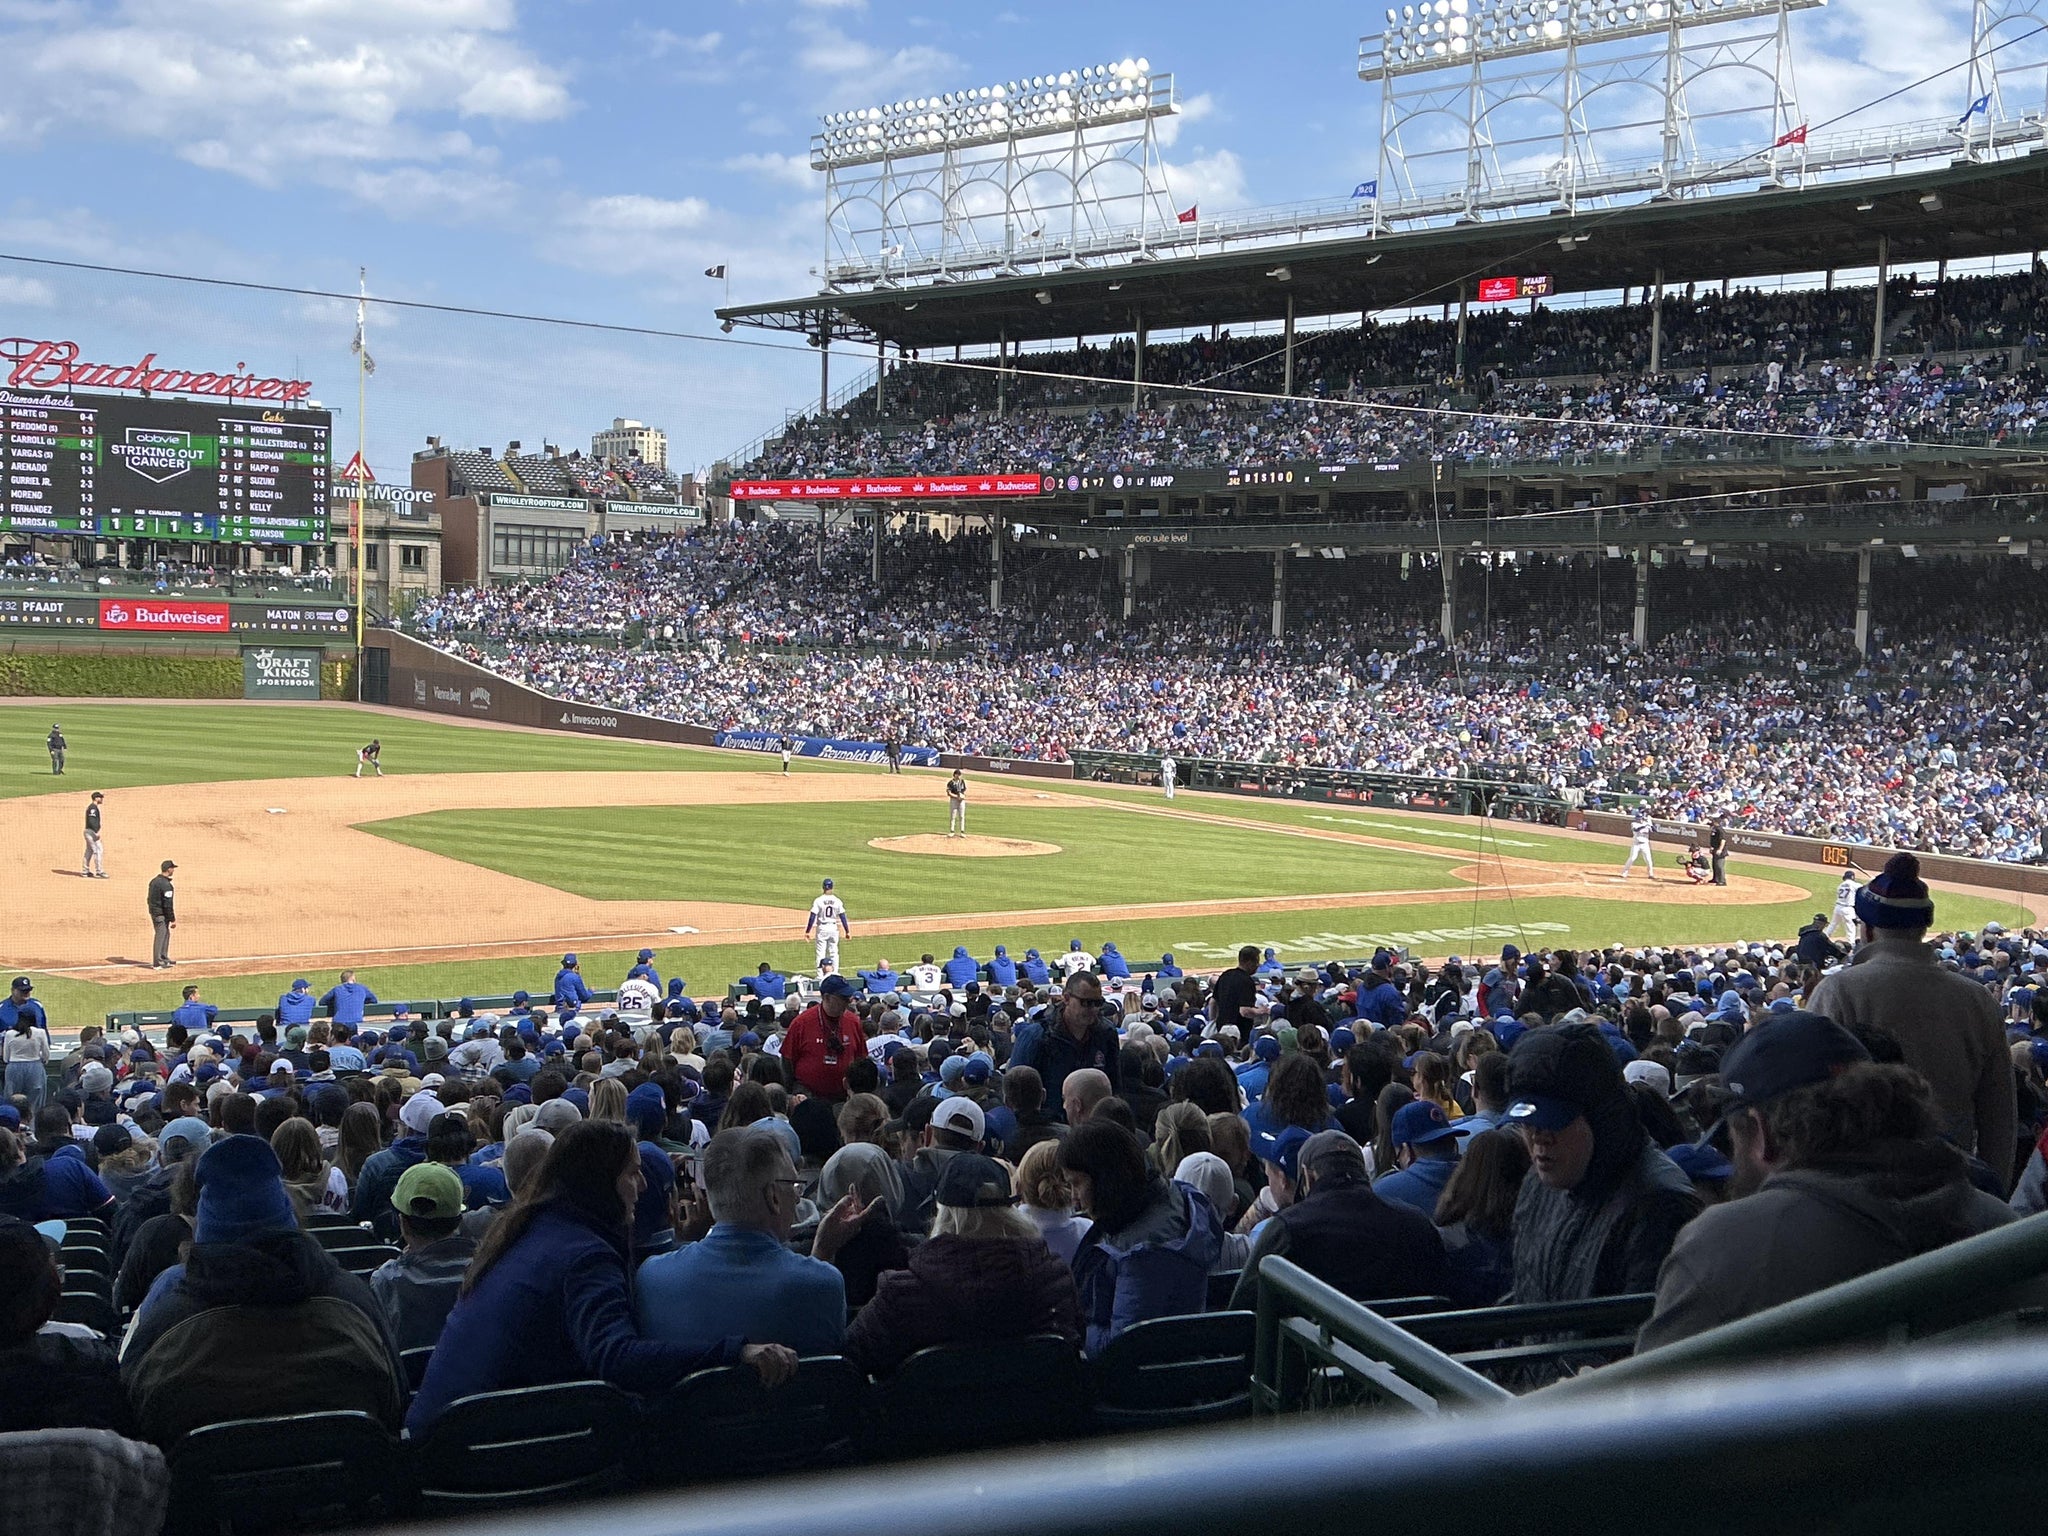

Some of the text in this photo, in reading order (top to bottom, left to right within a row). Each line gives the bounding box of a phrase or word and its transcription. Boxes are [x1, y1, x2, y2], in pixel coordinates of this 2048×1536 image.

[1538, 284, 1547, 294] 17
[0, 338, 312, 400] Budweiser
[0, 391, 74, 407] Diamondbacks
[11, 408, 37, 418] MARTE
[80, 413, 94, 421] 0-4
[262, 410, 286, 423] Cubs
[11, 422, 47, 431] PERDOMO
[81, 426, 93, 435] 1-3
[221, 423, 227, 431] 2
[250, 425, 283, 435] HOERNER
[314, 430, 325, 438] 1-4
[11, 435, 45, 445] CARROLL
[80, 439, 93, 448] 0-2
[136, 434, 180, 444] abbvie
[219, 436, 228, 444] 25
[234, 437, 244, 445] DH
[250, 438, 298, 449] BALLESTEROS
[313, 442, 325, 451] 2-3
[11, 448, 43, 458] VARGAS
[80, 453, 93, 461] 0-3
[111, 445, 205, 460] STRIKING OUT
[221, 449, 227, 457] 3
[250, 451, 284, 460] BREGMAN
[312, 455, 325, 463] 0-4
[11, 462, 93, 475] ARENADO 1-3
[131, 456, 185, 468] CANCER
[234, 463, 243, 471] LF
[250, 464, 270, 472] HAPP
[313, 468, 325, 476] 0-2
[11, 476, 40, 485] GURRIEL
[80, 480, 93, 488] 2-3
[219, 475, 325, 489] 27 RF SUZUKI 1-3
[1058, 478, 1104, 489] 2 6 7
[1137, 478, 1145, 486] LF
[1150, 476, 1174, 487] HAPP
[1253, 472, 1259, 484] 1
[1262, 473, 1267, 482] S
[1270, 472, 1275, 483] 1
[11, 490, 93, 502] MORENO 1-3
[233, 489, 243, 497] 1B
[250, 490, 273, 499] BUSCH
[313, 493, 325, 502] 2-2
[374, 484, 431, 503] Moore
[235, 502, 241, 510] C
[250, 503, 272, 512] KELLY
[313, 507, 325, 515] 1-3
[496, 496, 584, 509] WRIGLEYROOFTOPS.COM
[11, 504, 93, 516] FERNANDEZ 0-2
[611, 503, 695, 516] WRIGLEYROOFTOPS.COM
[11, 517, 47, 527] BARROSA
[80, 521, 93, 529] 0-2
[112, 518, 203, 534] 1 2 1 3
[220, 515, 226, 523] 4
[313, 520, 324, 528] 1-3
[220, 528, 324, 541] 7 SS SWANSON 0-2
[1171, 533, 1188, 543] level
[5, 602, 64, 612] 32 PFAADT
[45, 616, 49, 624] 1
[135, 607, 224, 625] Budweiser
[266, 609, 301, 620] MATON
[256, 657, 311, 669] DRAFT
[263, 667, 310, 678] KINGS
[571, 713, 618, 728] Invesco QQQ
[721, 734, 763, 750] Reynolds
[819, 744, 869, 761] Reynolds
[1741, 837, 1772, 848] Advocate
[1839, 888, 1850, 898] 27
[826, 906, 832, 917] 0
[1172, 920, 1546, 959] Southwest
[1077, 963, 1085, 971] 2
[925, 973, 933, 983] 3
[622, 996, 643, 1009] 25
